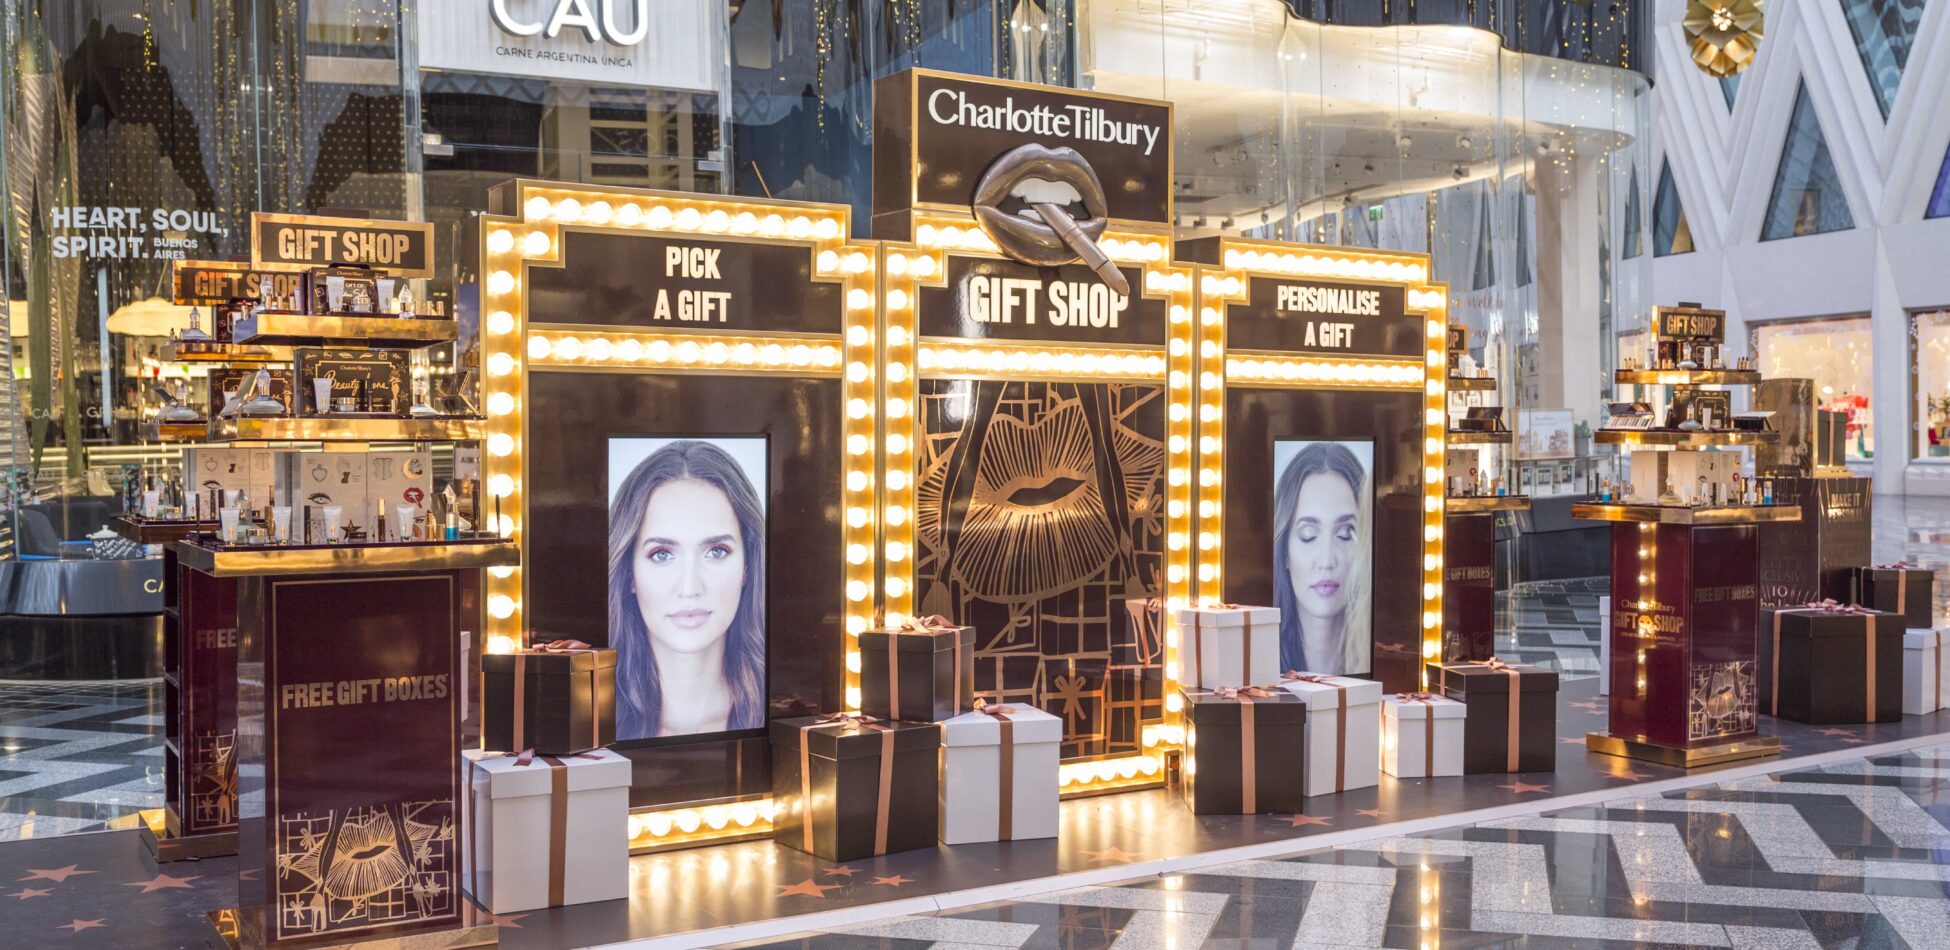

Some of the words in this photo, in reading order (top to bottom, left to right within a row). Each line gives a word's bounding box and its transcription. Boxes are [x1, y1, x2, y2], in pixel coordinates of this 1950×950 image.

[489, 0, 649, 46] CAU
[496, 46, 533, 59] CARNE
[536, 50, 598, 65] ARGENTINA
[52, 206, 147, 234] HEART,
[152, 208, 229, 238] SOUL,
[52, 236, 149, 259] SPIRIT.
[153, 237, 198, 249] BUENOS
[153, 250, 186, 260] AIRES
[278, 227, 337, 261] GIFT
[342, 230, 410, 265] SHOP
[665, 246, 722, 280] PICK
[194, 271, 243, 297] GIFT
[653, 289, 672, 320] A
[677, 289, 732, 322] GIFT
[969, 275, 1042, 325] GIFT
[1048, 280, 1129, 329] SHOP
[1277, 284, 1380, 316] PERSONALISE
[1303, 321, 1317, 347] A
[1319, 321, 1355, 348] GIFT
[1666, 314, 1690, 335] GIFT
[1691, 316, 1717, 336] SHOP
[1831, 493, 1852, 508] MAKE
[1853, 492, 1861, 507] IT
[1694, 587, 1713, 603] FREE
[1731, 584, 1755, 600] BOXES
[1614, 611, 1638, 630] GIFT
[1654, 616, 1684, 633] SHOP
[196, 628, 237, 650] FREE
[282, 681, 334, 710] FREE
[337, 678, 382, 706] GIFT
